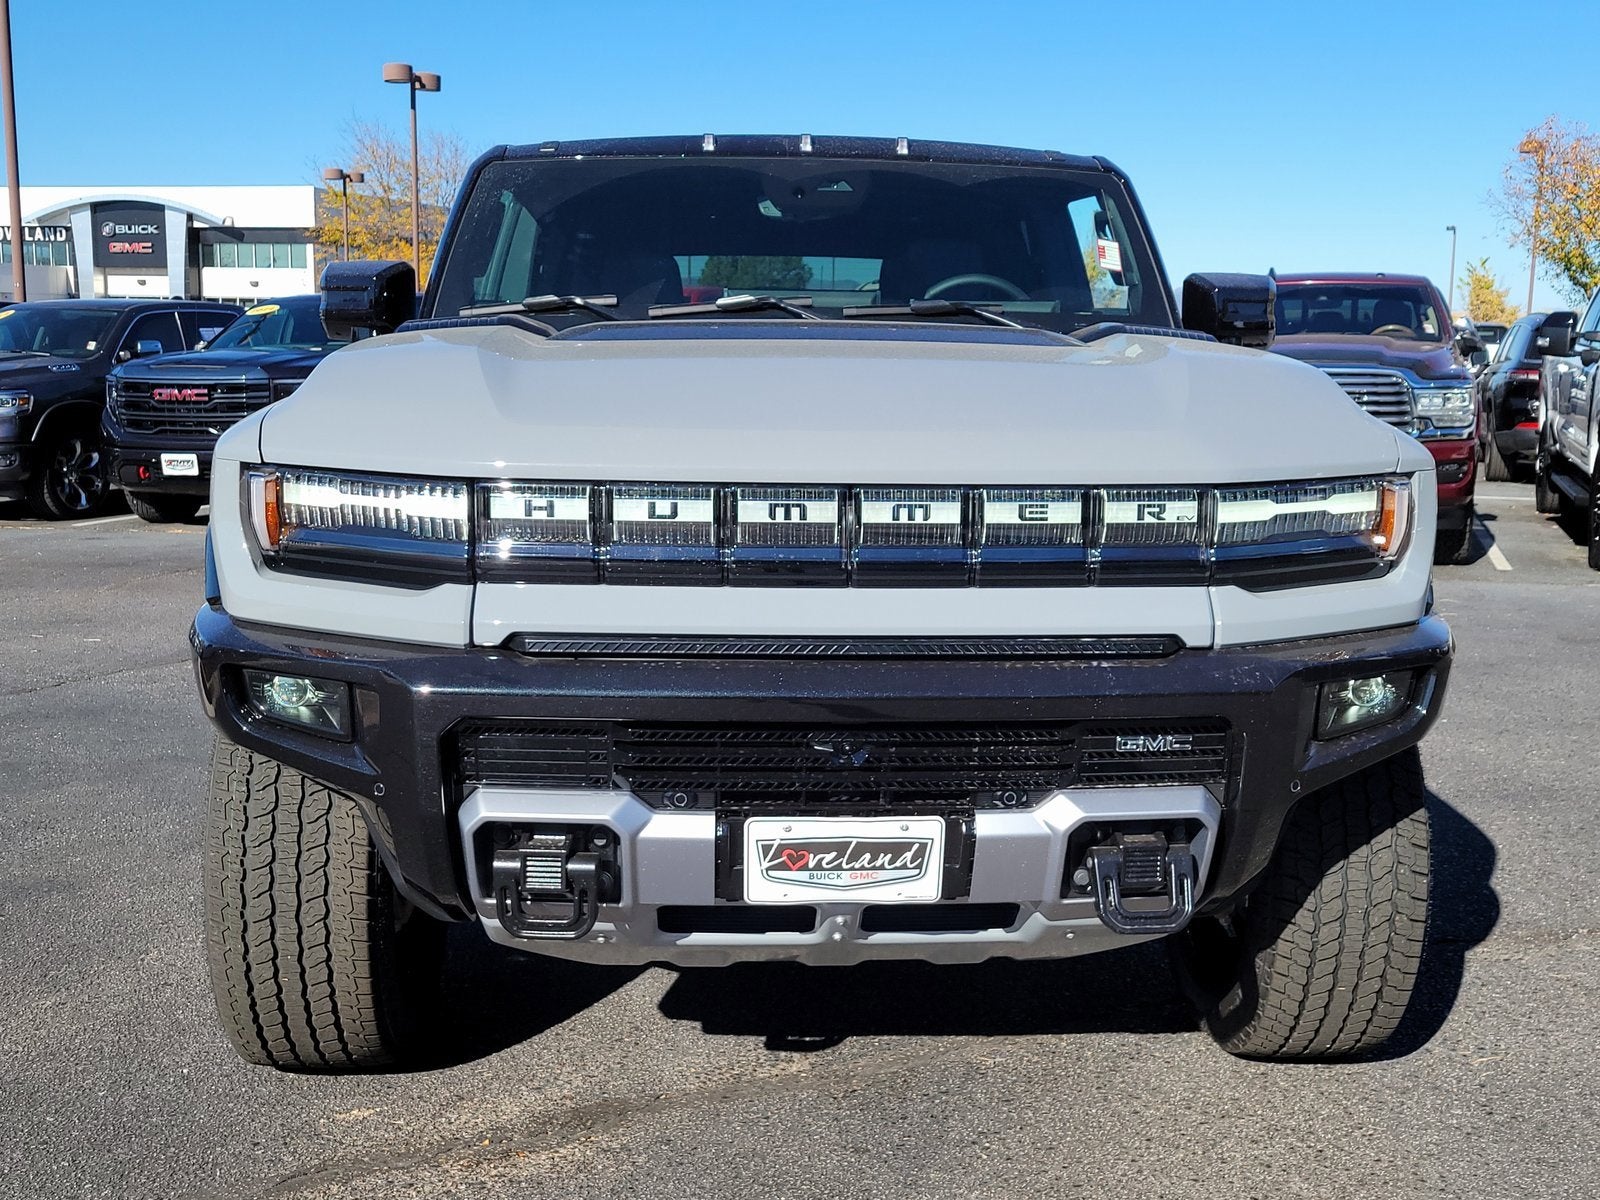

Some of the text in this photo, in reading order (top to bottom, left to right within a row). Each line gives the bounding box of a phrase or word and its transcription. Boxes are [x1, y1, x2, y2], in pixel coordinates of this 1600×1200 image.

[115, 224, 159, 234] BUICK
[108, 242, 153, 253] GMC
[153, 388, 209, 401] GMC
[1115, 734, 1193, 752] GMC
[808, 872, 880, 880] BUICK GMC
